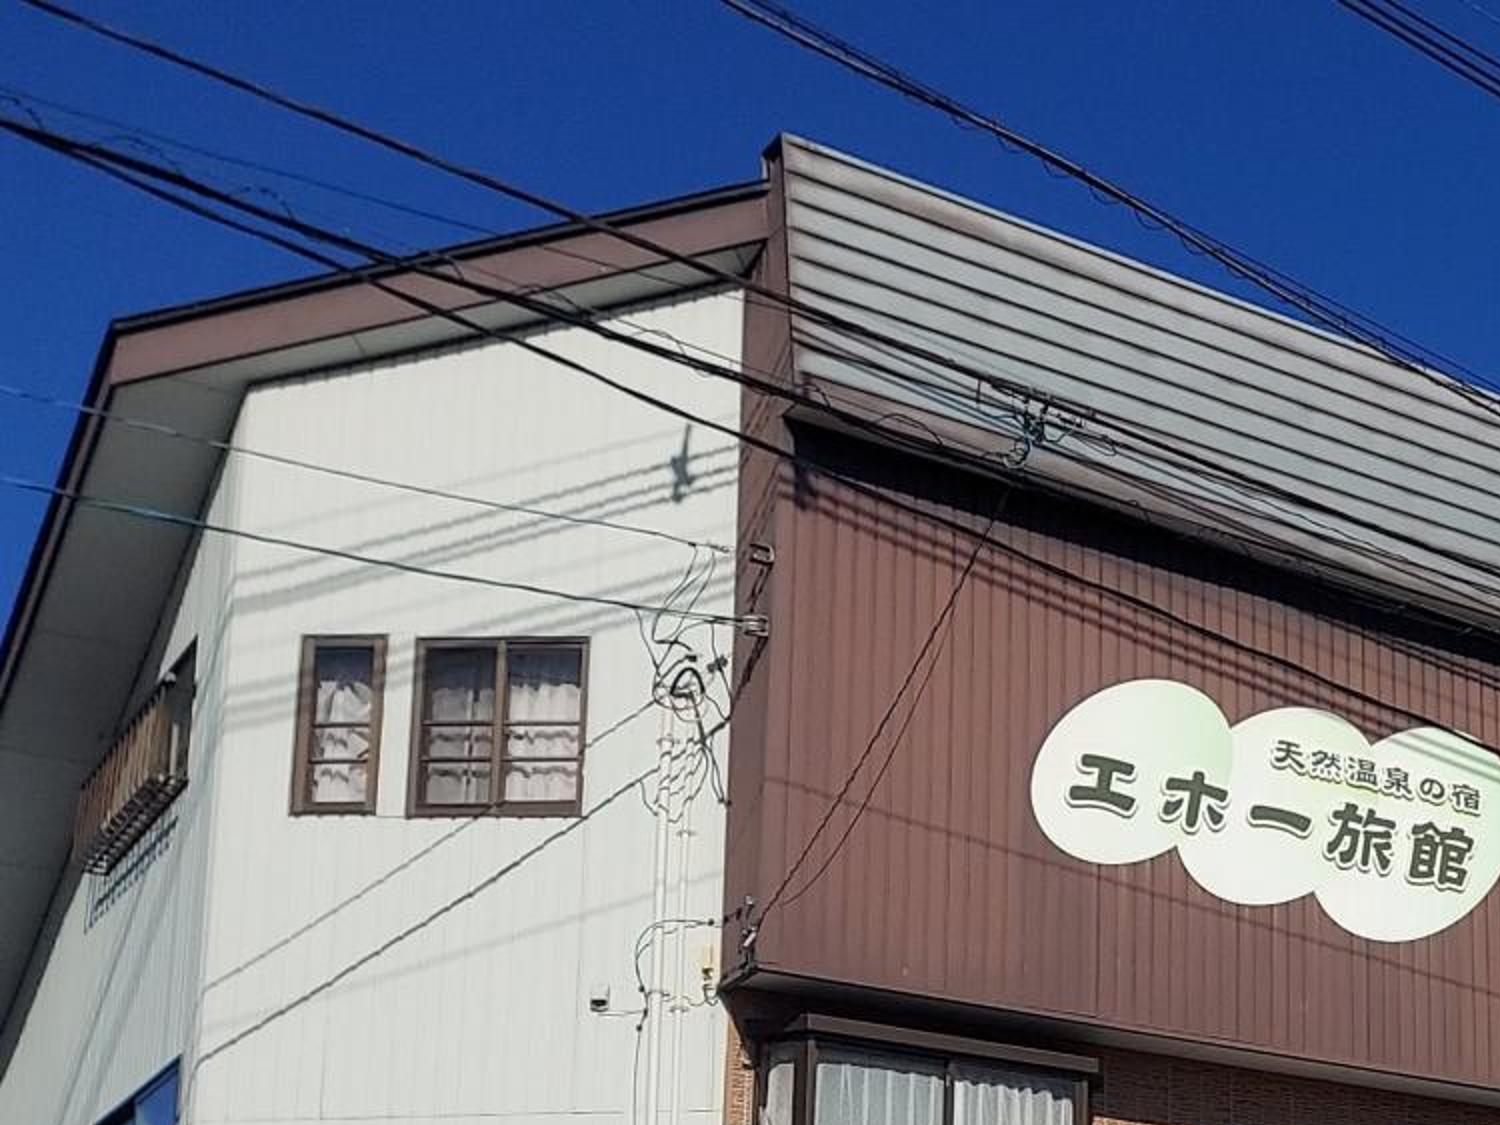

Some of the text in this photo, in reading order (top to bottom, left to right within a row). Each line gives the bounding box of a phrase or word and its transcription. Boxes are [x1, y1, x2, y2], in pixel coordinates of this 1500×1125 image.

[1272, 738, 1481, 812] 天然温泉の宿
